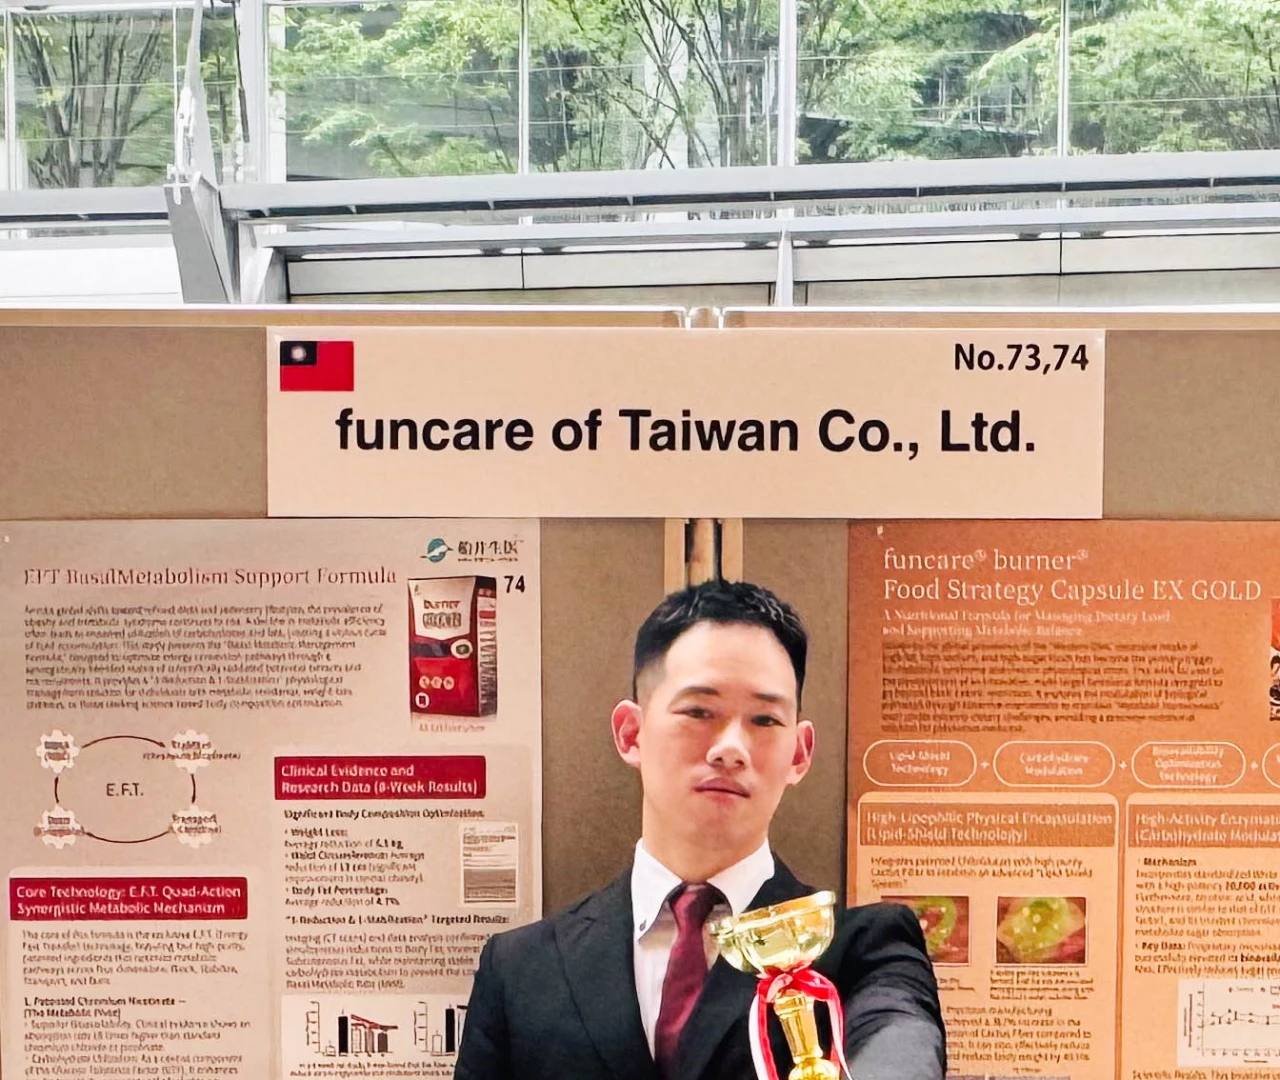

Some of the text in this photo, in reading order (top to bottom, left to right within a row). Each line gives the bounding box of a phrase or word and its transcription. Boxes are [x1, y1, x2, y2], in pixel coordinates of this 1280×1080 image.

[954, 343, 1089, 374] No.73,74
[335, 407, 1036, 459] funcare of Taiwan Co., Ltd.
[233, 566, 311, 589] Support
[317, 566, 397, 585] Formula
[503, 574, 526, 594] 74
[883, 578, 1263, 606] Food Strategy Capsule EX GOLD
[280, 763, 416, 778] Clinical Evidence and
[280, 781, 340, 795] Research
[341, 780, 372, 795] Data
[427, 778, 479, 796] Results)
[16, 885, 47, 899] Core
[50, 885, 124, 901] Technology:
[162, 885, 241, 899] Quad-Action
[88, 902, 151, 915] Metabolic
[153, 902, 226, 914] Mechanism
